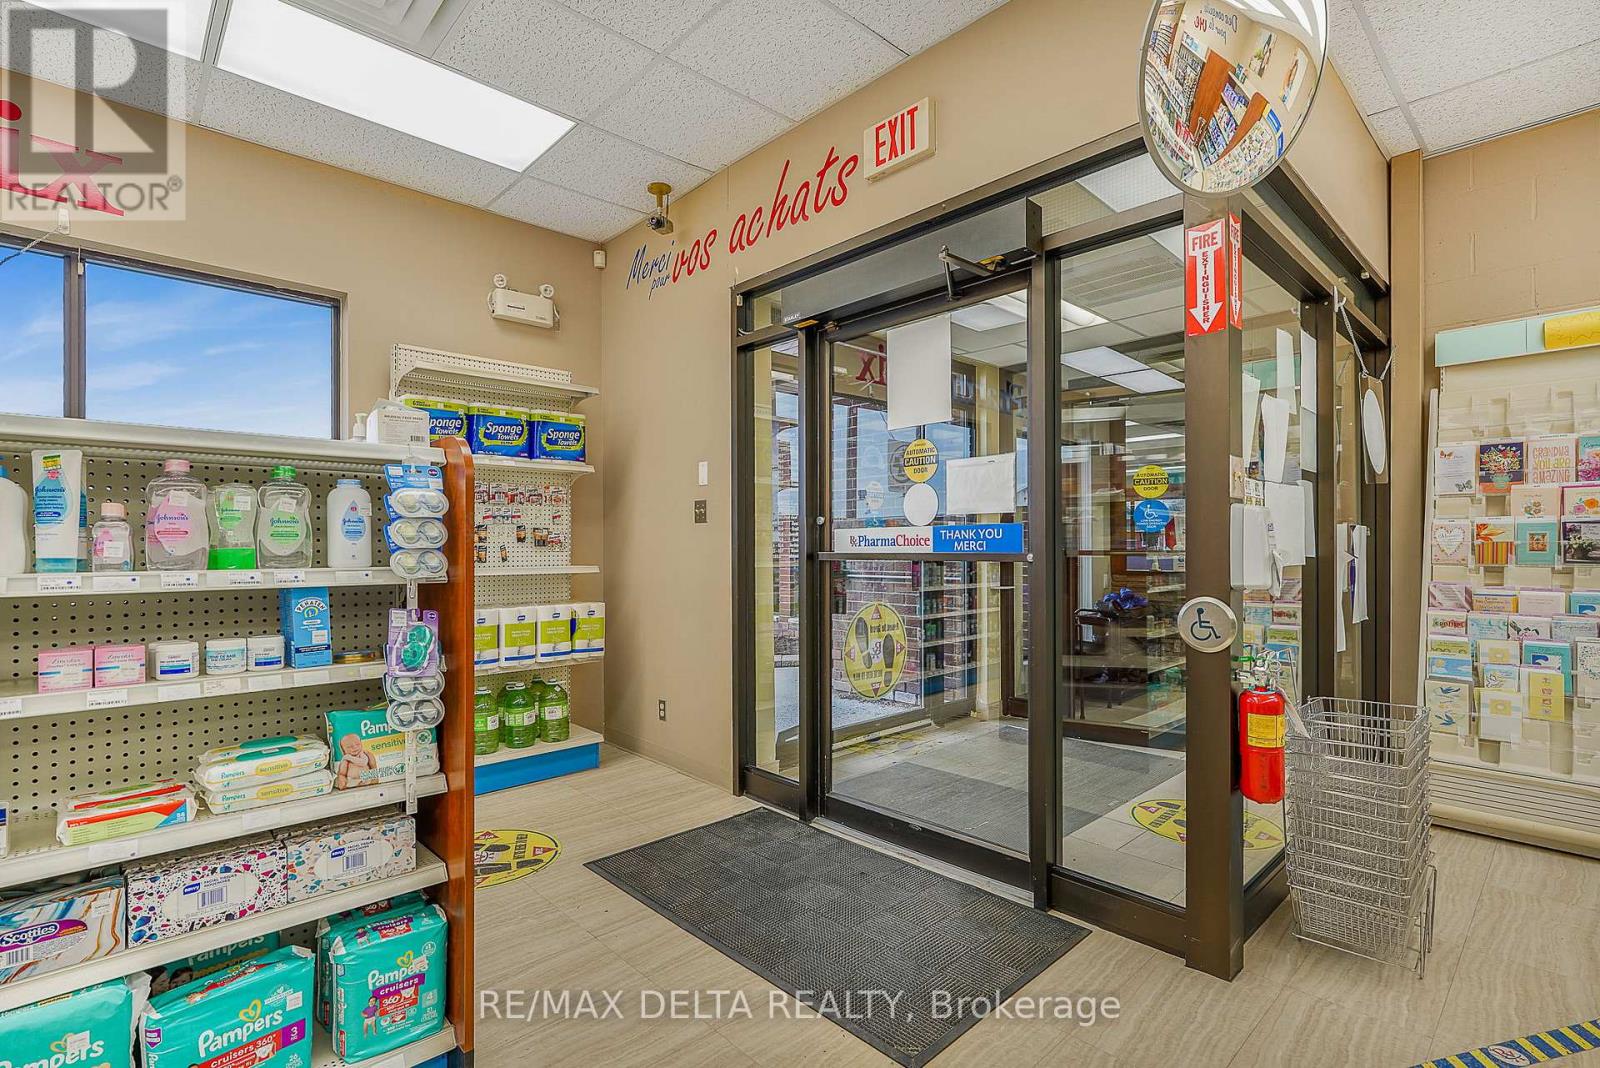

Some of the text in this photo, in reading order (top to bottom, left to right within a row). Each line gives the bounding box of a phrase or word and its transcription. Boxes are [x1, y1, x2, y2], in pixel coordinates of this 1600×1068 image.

[874, 105, 919, 167] EXIT
[672, 146, 859, 283] vos achats
[1191, 231, 1218, 252] FIRE
[626, 239, 675, 289] Merci
[648, 273, 671, 300] pour
[1201, 251, 1211, 324] EXTINGUISHER
[430, 418, 462, 429] ponge
[485, 422, 522, 434] Sponge
[434, 427, 459, 435] Towels
[497, 433, 519, 441] Towels
[547, 428, 580, 441] Sponge
[905, 447, 936, 456] AUTOMATIC
[904, 456, 936, 467] CAUTION
[1134, 478, 1168, 486] CAUTION
[156, 512, 189, 524] Johnson's
[271, 516, 299, 527] Johnson's
[940, 528, 1003, 540] THANK YOU
[953, 540, 986, 551] MERCI
[370, 739, 407, 751] sensitiv
[221, 770, 245, 779] Pampers
[222, 793, 246, 802] Pampers
[184, 884, 200, 893] envy
[2, 925, 56, 946] Scotties
[379, 977, 419, 996] cruisers
[198, 1009, 284, 1059] Pampers
[291, 1026, 298, 1037] 3
